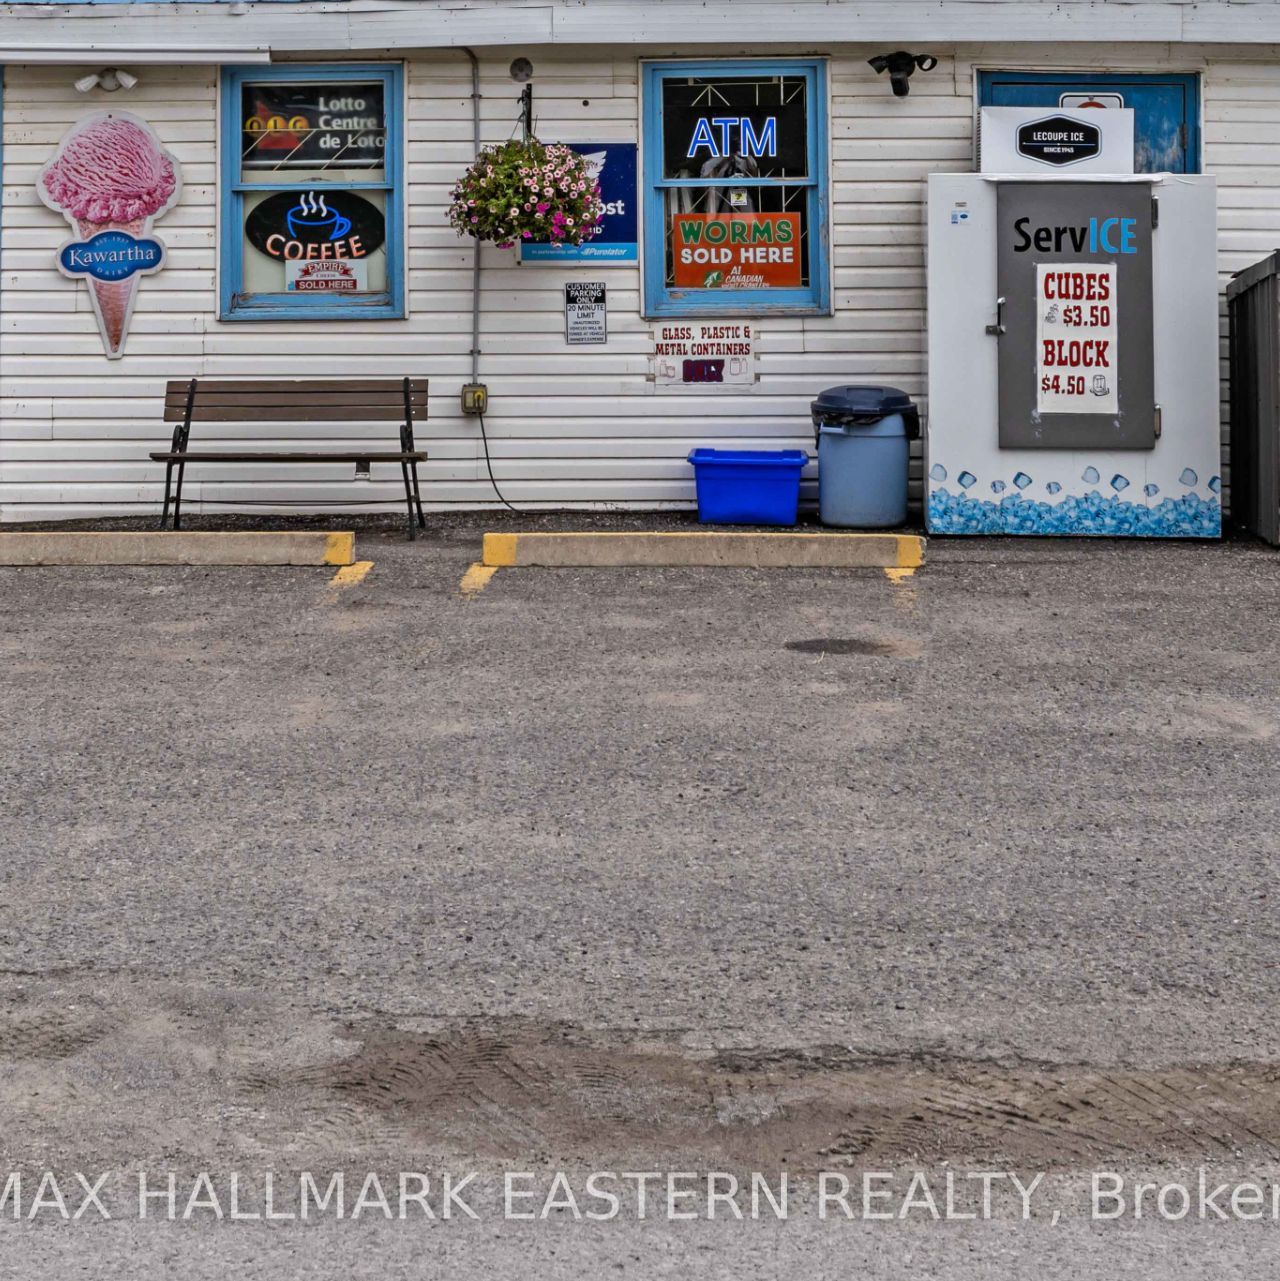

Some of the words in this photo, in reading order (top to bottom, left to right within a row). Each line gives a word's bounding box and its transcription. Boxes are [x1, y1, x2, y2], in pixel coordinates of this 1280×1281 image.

[319, 97, 365, 111] Lotto
[319, 115, 377, 129] Centre
[319, 134, 341, 148] de
[347, 134, 385, 148] Loto
[687, 117, 777, 157] ATM
[1033, 132, 1069, 141] LECOUPE
[1071, 132, 1085, 141] ICE
[680, 220, 794, 244] WORMS
[1013, 216, 1137, 254] ServICE
[266, 234, 366, 260] COFFEE
[586, 248, 627, 256] Purolator
[69, 246, 154, 266] Kawartha
[680, 247, 733, 264] SOLD
[741, 247, 794, 263] HERE
[308, 262, 344, 272] EMPIRE
[299, 281, 325, 289] SOLD
[725, 275, 764, 283] CANADIAN
[1044, 272, 1110, 301] CUBES
[1063, 305, 1110, 327] $3.50
[662, 327, 695, 340] GLASS,
[701, 327, 740, 338] PLASTIC
[743, 326, 751, 338] &
[655, 343, 688, 355] METAL
[691, 343, 750, 355] CONTAINERS
[1043, 339, 1109, 368] BLOCK
[1041, 374, 1085, 395] $4.50
